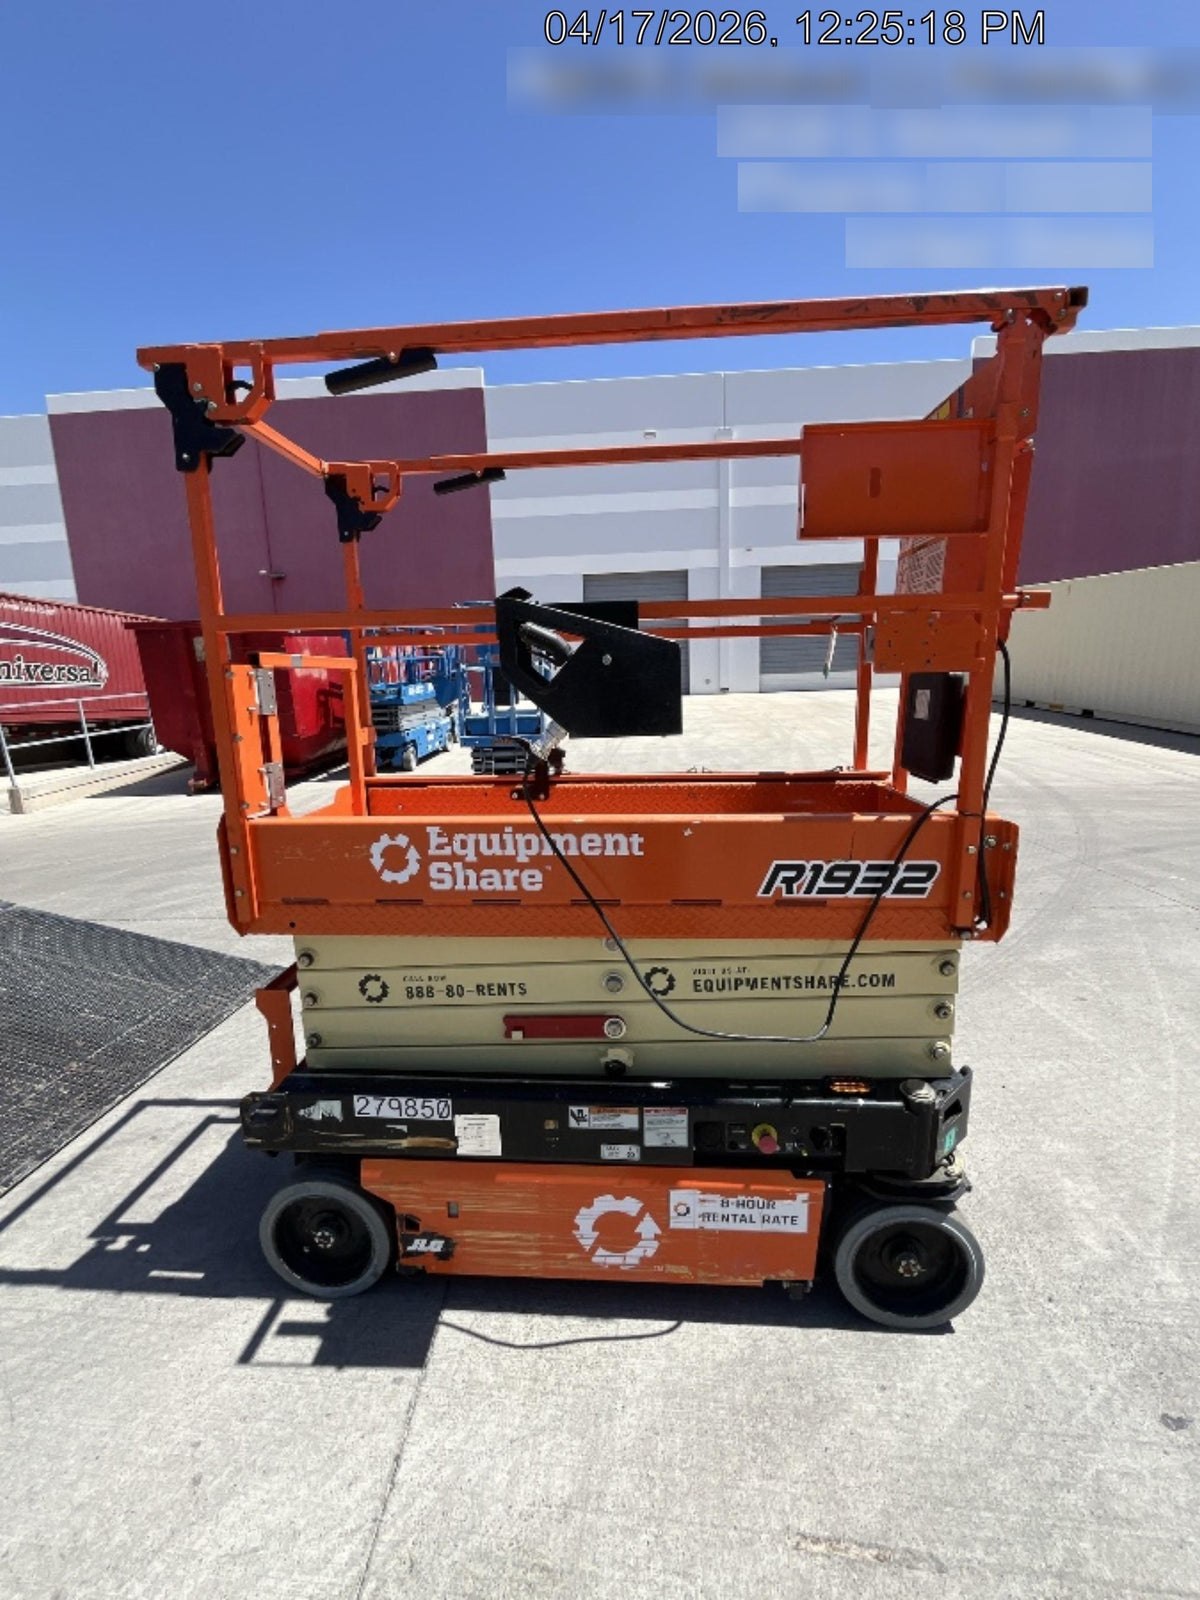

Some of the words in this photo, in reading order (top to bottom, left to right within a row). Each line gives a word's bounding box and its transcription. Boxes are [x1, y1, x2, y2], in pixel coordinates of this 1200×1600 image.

[426, 826, 644, 862] Equipment
[429, 862, 543, 891] Share
[757, 860, 941, 898] R1932
[405, 982, 528, 999] 888-80-RENTS
[693, 973, 895, 992] EQUIPMENTSHARE.COM
[356, 1096, 450, 1119] 279850
[762, 1215, 799, 1226] RATE
